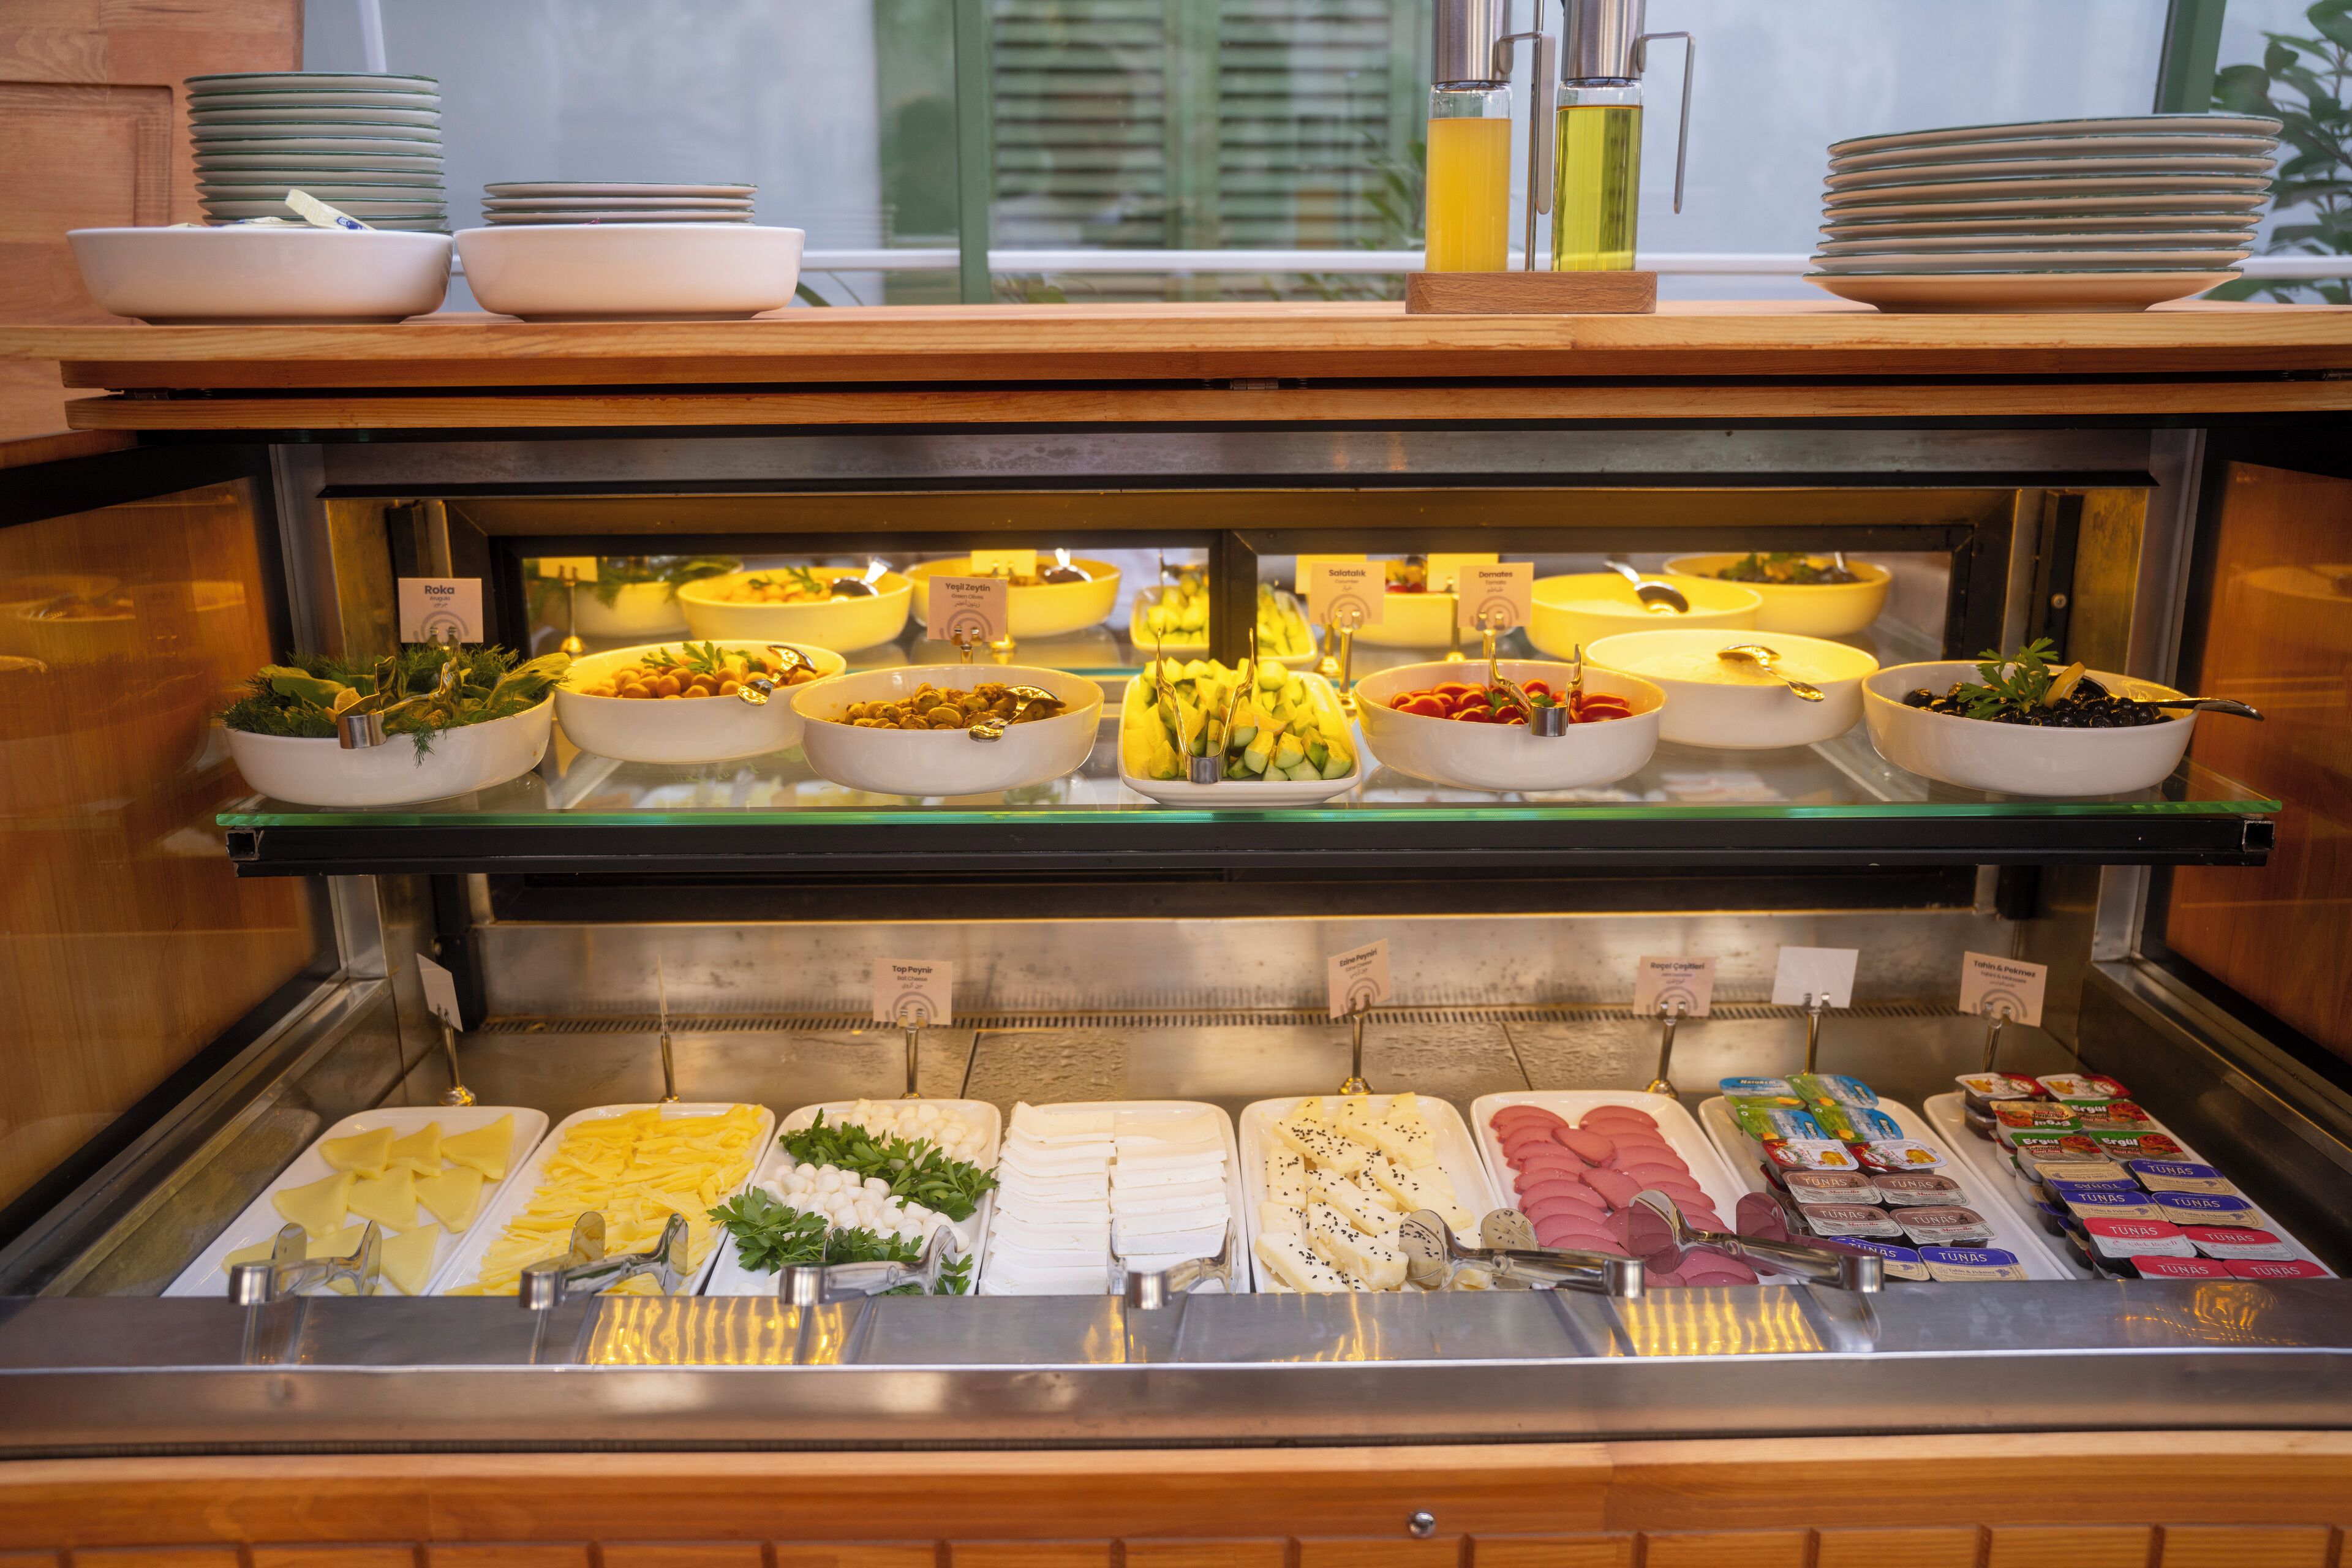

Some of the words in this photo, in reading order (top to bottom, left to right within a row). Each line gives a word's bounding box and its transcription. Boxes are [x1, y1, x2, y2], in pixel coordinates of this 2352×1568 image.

[424, 586, 454, 594] Roka
[945, 583, 964, 592] Yeşil
[965, 584, 990, 593] Zeytin
[1340, 958, 1355, 967] Ezine
[1973, 960, 1996, 970] Tahin
[892, 965, 907, 974] Top
[2147, 1165, 2193, 1175] TUNAS
[2079, 1194, 2125, 1202] TUNAS
[2172, 1199, 2220, 1207] TUNAS
[2109, 1226, 2158, 1235] TUNAS
[1939, 1252, 1987, 1262] TUNAS
[2158, 1264, 2209, 1274] TUNAS
[2250, 1267, 2301, 1275] TUNAS
